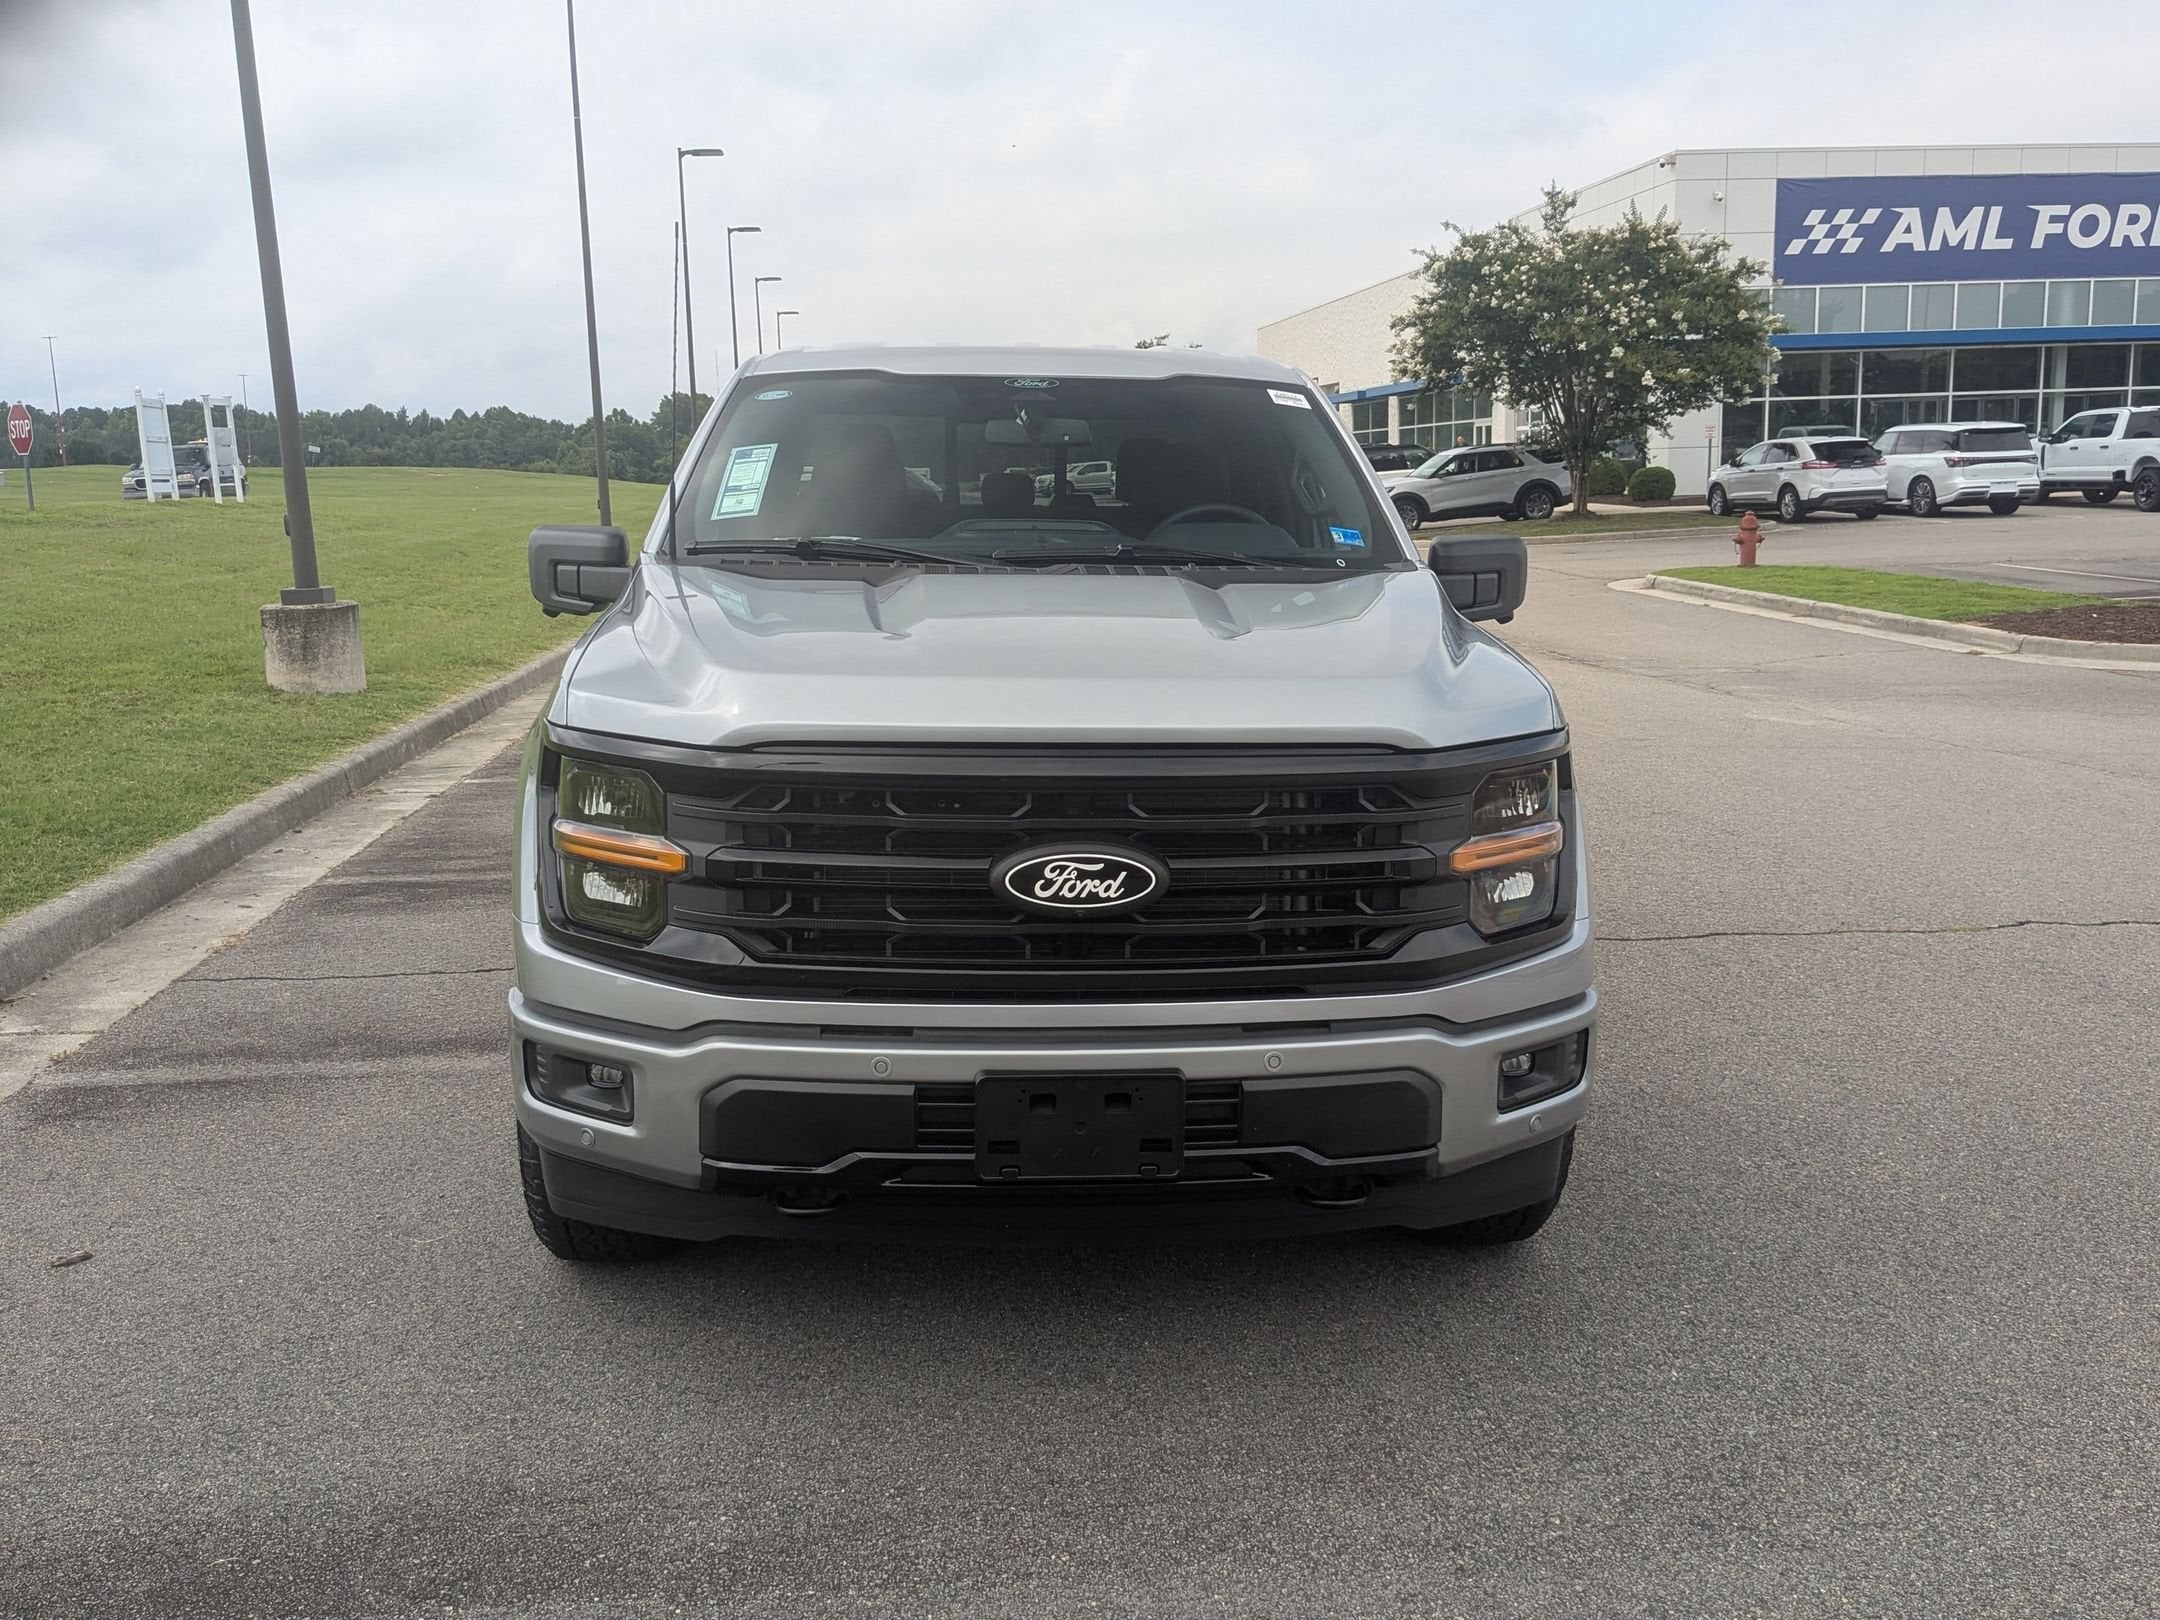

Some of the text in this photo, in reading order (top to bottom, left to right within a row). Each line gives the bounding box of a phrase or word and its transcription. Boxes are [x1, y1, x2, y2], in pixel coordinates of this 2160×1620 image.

[1879, 203, 2160, 252] AML FOR
[10, 419, 30, 439] STOP
[1034, 861, 1127, 898] Ford
